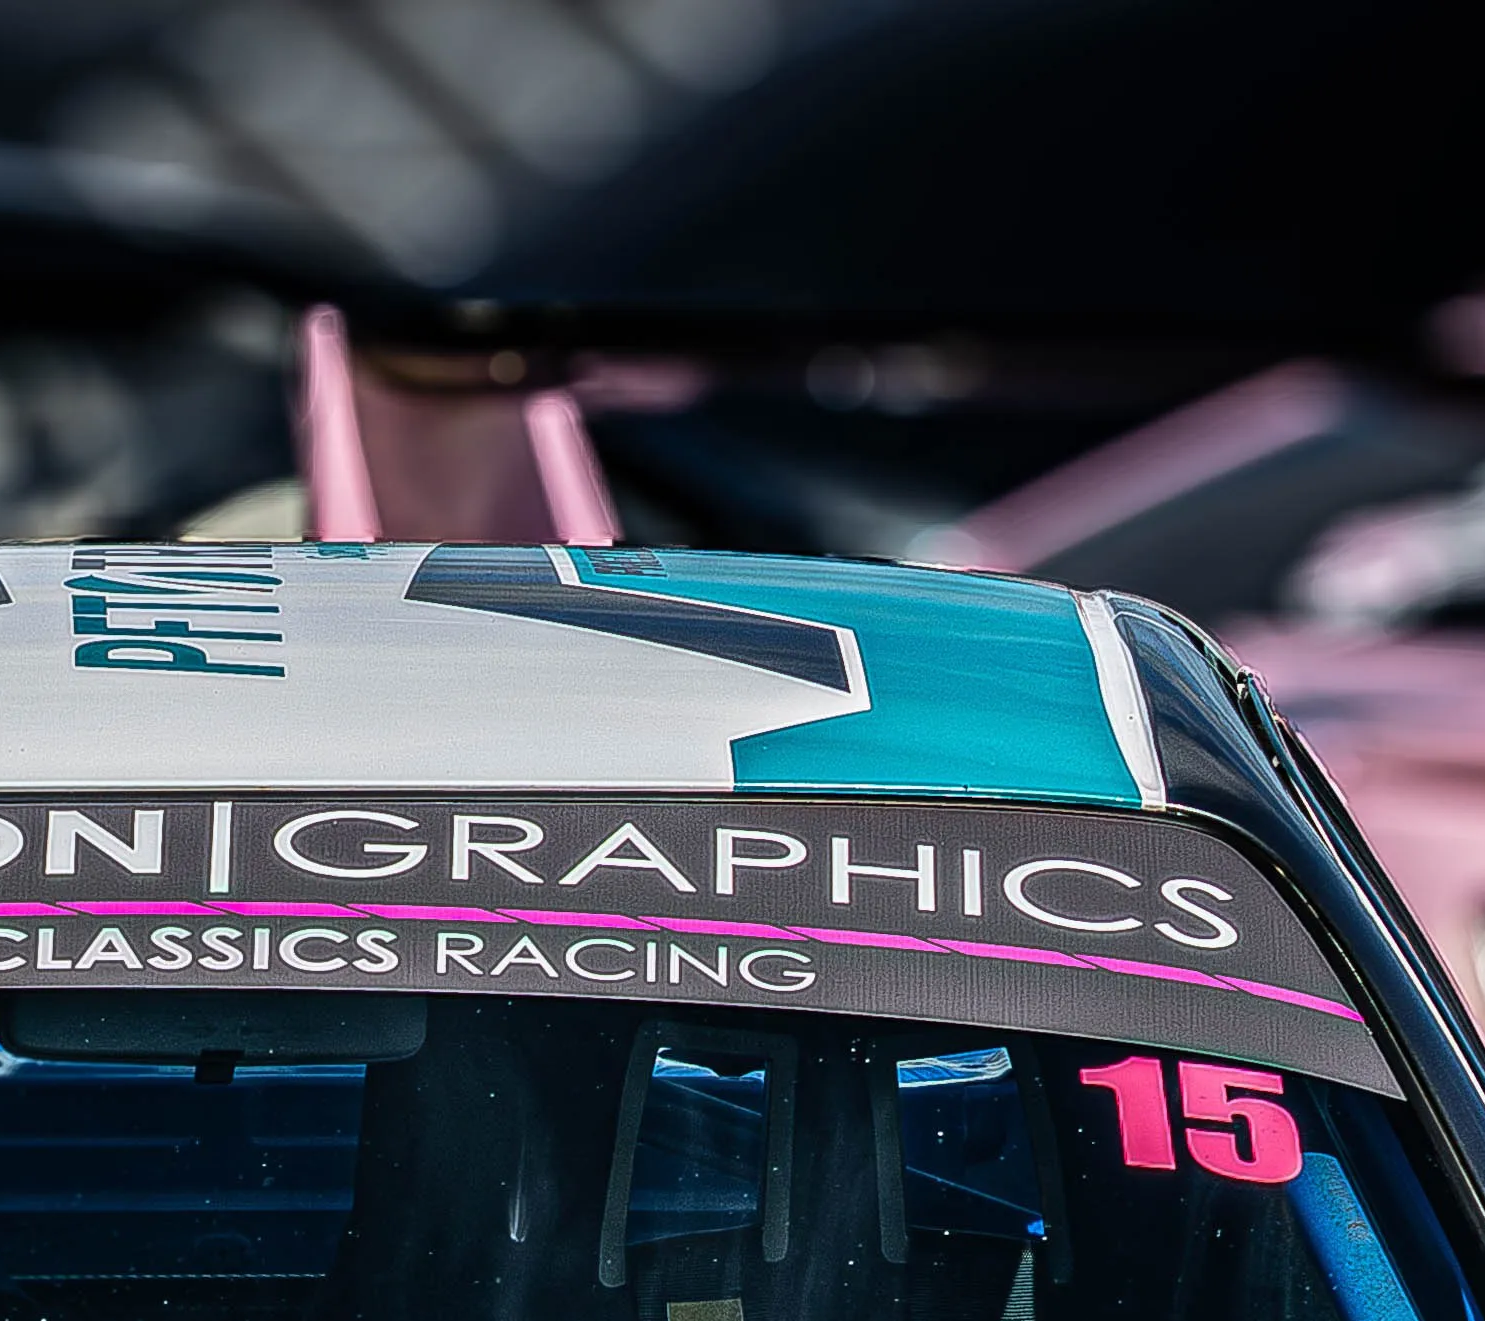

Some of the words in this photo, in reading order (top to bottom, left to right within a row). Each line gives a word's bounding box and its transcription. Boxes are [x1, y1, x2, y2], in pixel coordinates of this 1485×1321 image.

[271, 809, 1240, 952] GRAPHICS
[434, 931, 819, 992] RACING
[1080, 1056, 1302, 1183] 15
